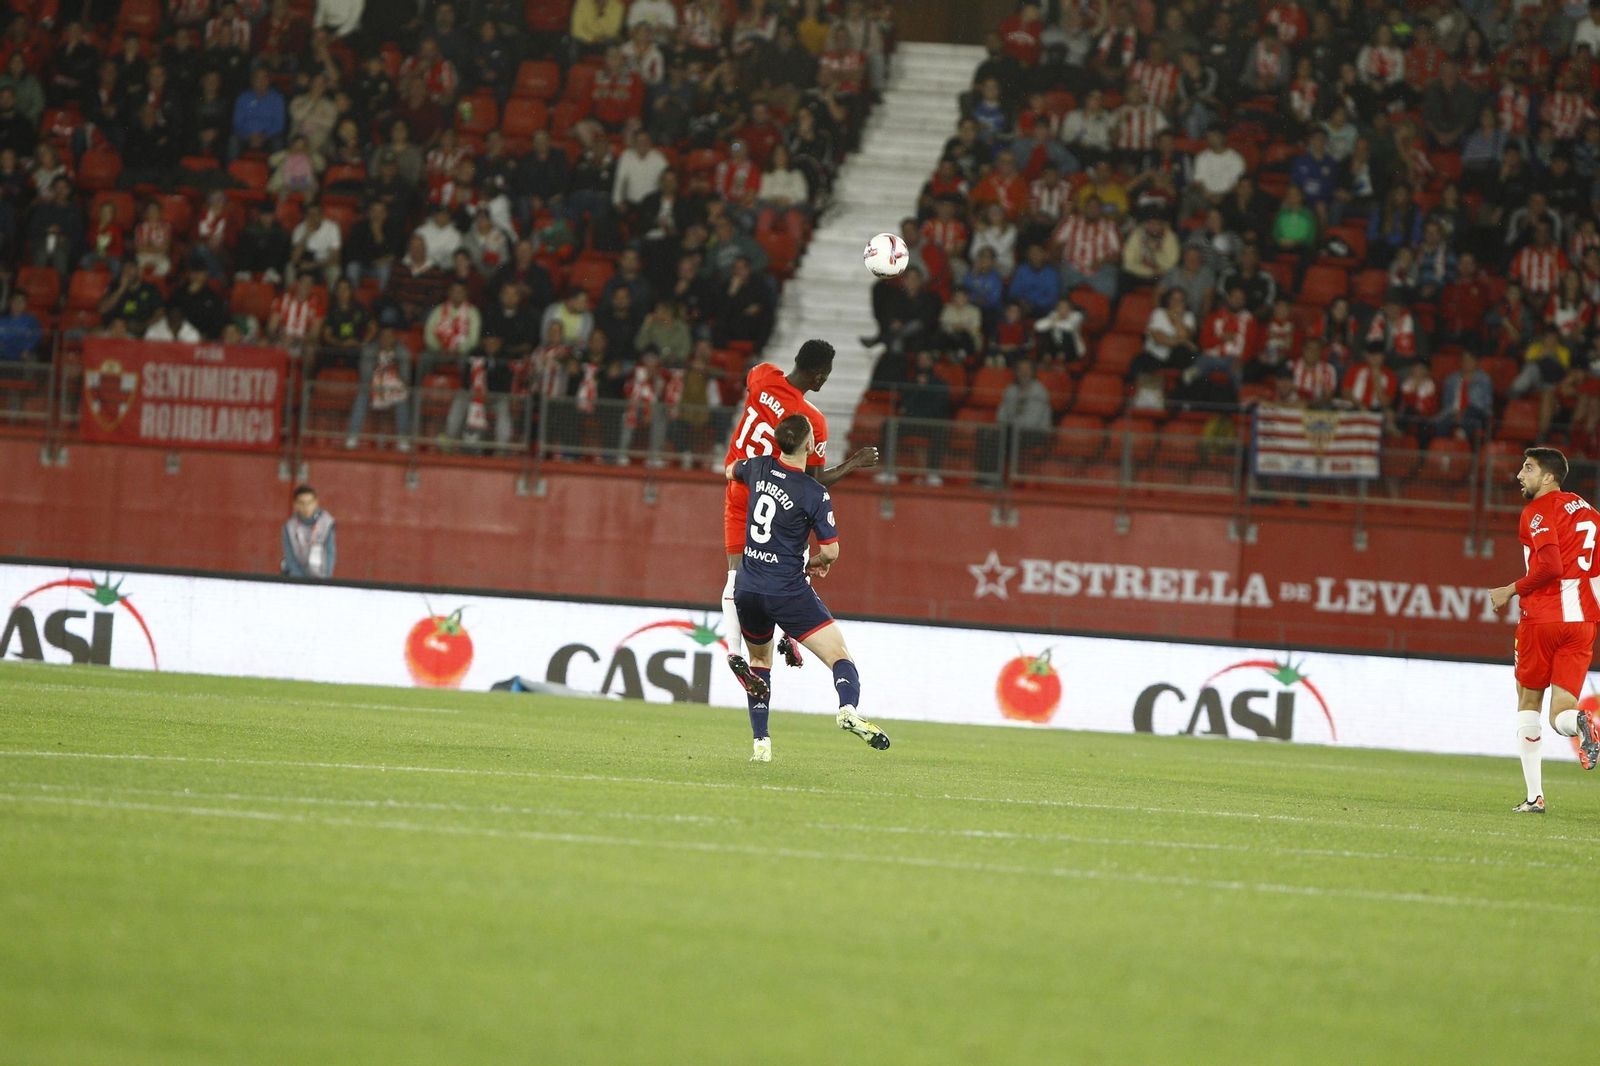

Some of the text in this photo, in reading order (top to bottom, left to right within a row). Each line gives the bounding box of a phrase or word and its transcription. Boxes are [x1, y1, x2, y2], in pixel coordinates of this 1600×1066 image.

[143, 362, 278, 403] SENTIMIENTO
[759, 391, 785, 418] BABA
[141, 402, 274, 443] ROJIBLANCO
[736, 406, 775, 458] 15
[750, 494, 776, 544] 9
[756, 480, 794, 510] BARBERO
[1575, 520, 1597, 572] 3
[1020, 558, 1273, 608] ESTRELLA
[1279, 582, 1311, 602] DE
[546, 642, 712, 704] CASI
[1133, 682, 1294, 740] CASI
